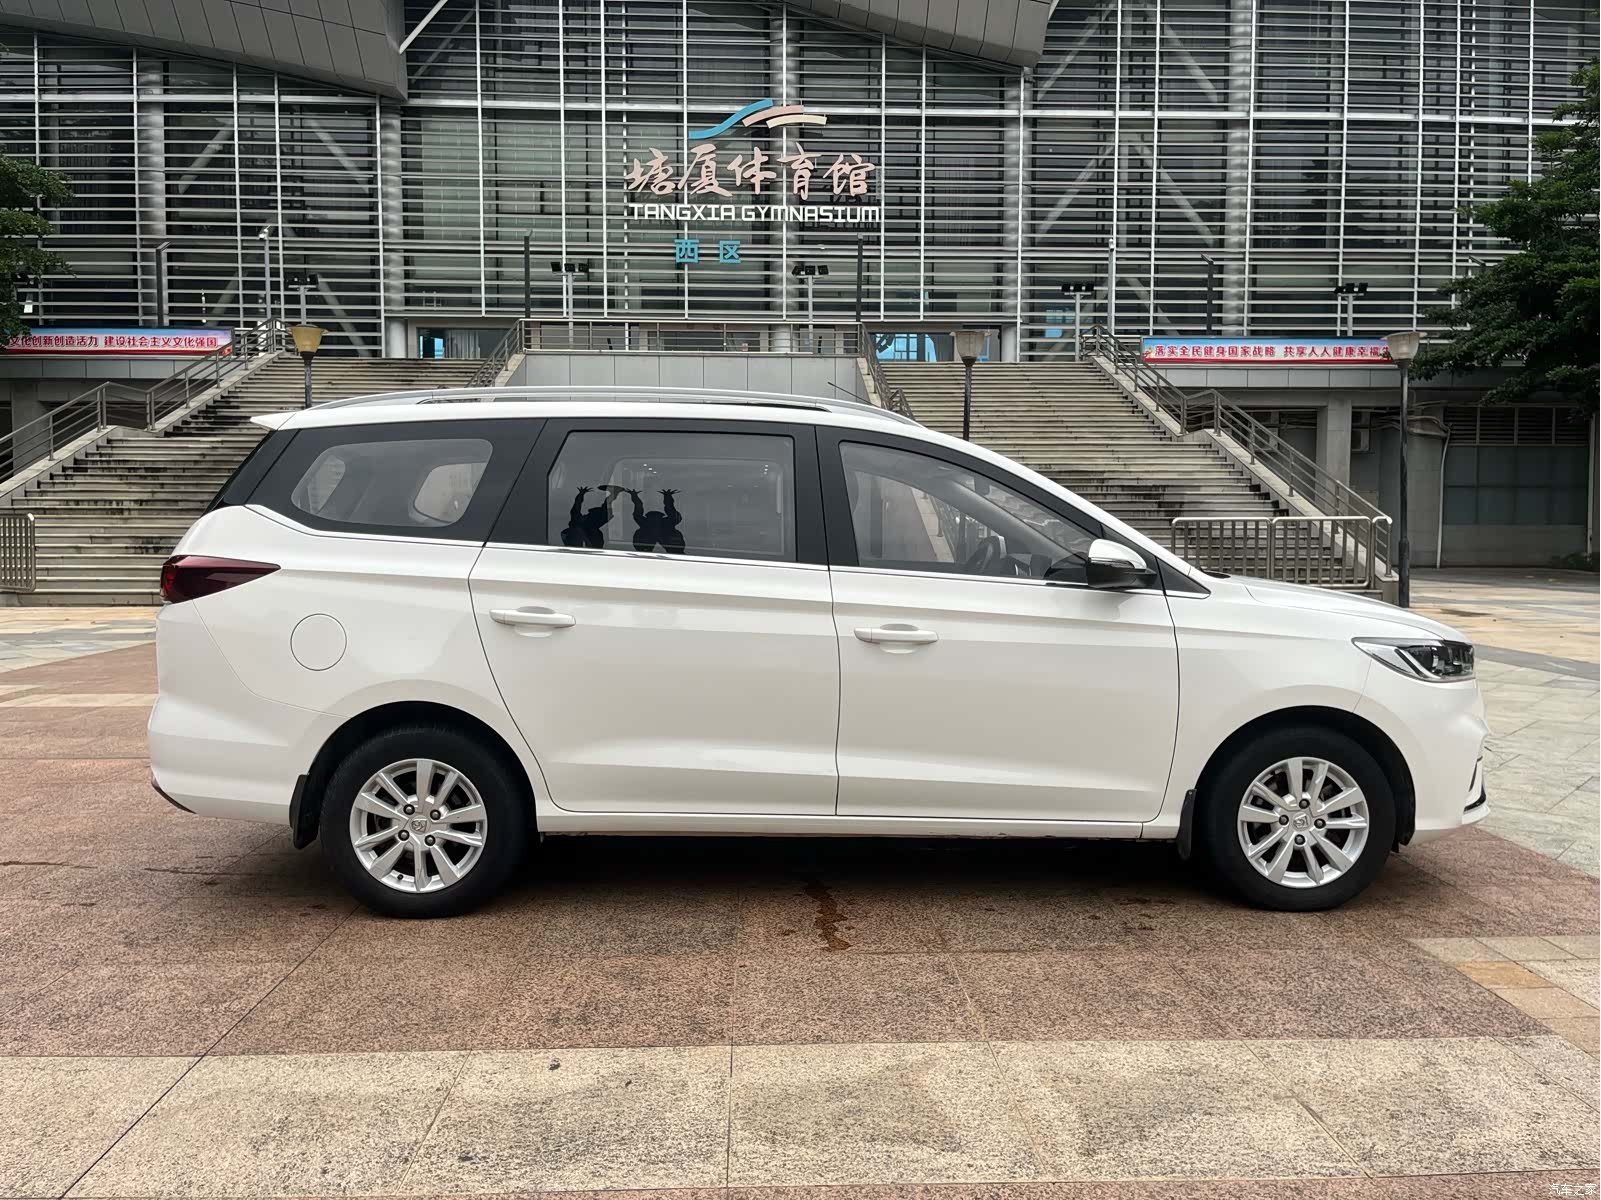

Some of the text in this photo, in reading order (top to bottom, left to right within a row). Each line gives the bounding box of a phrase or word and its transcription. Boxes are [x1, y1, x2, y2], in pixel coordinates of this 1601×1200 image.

[624, 142, 876, 200] 塘厦体育馆
[628, 203, 880, 222] TANGXIA GYMNASIUM
[674, 239, 741, 263] 西区
[10, 335, 218, 347] 文化创新创造活力 建设社会主义文化强国
[1155, 345, 1276, 357] 落实全民健身国家战略
